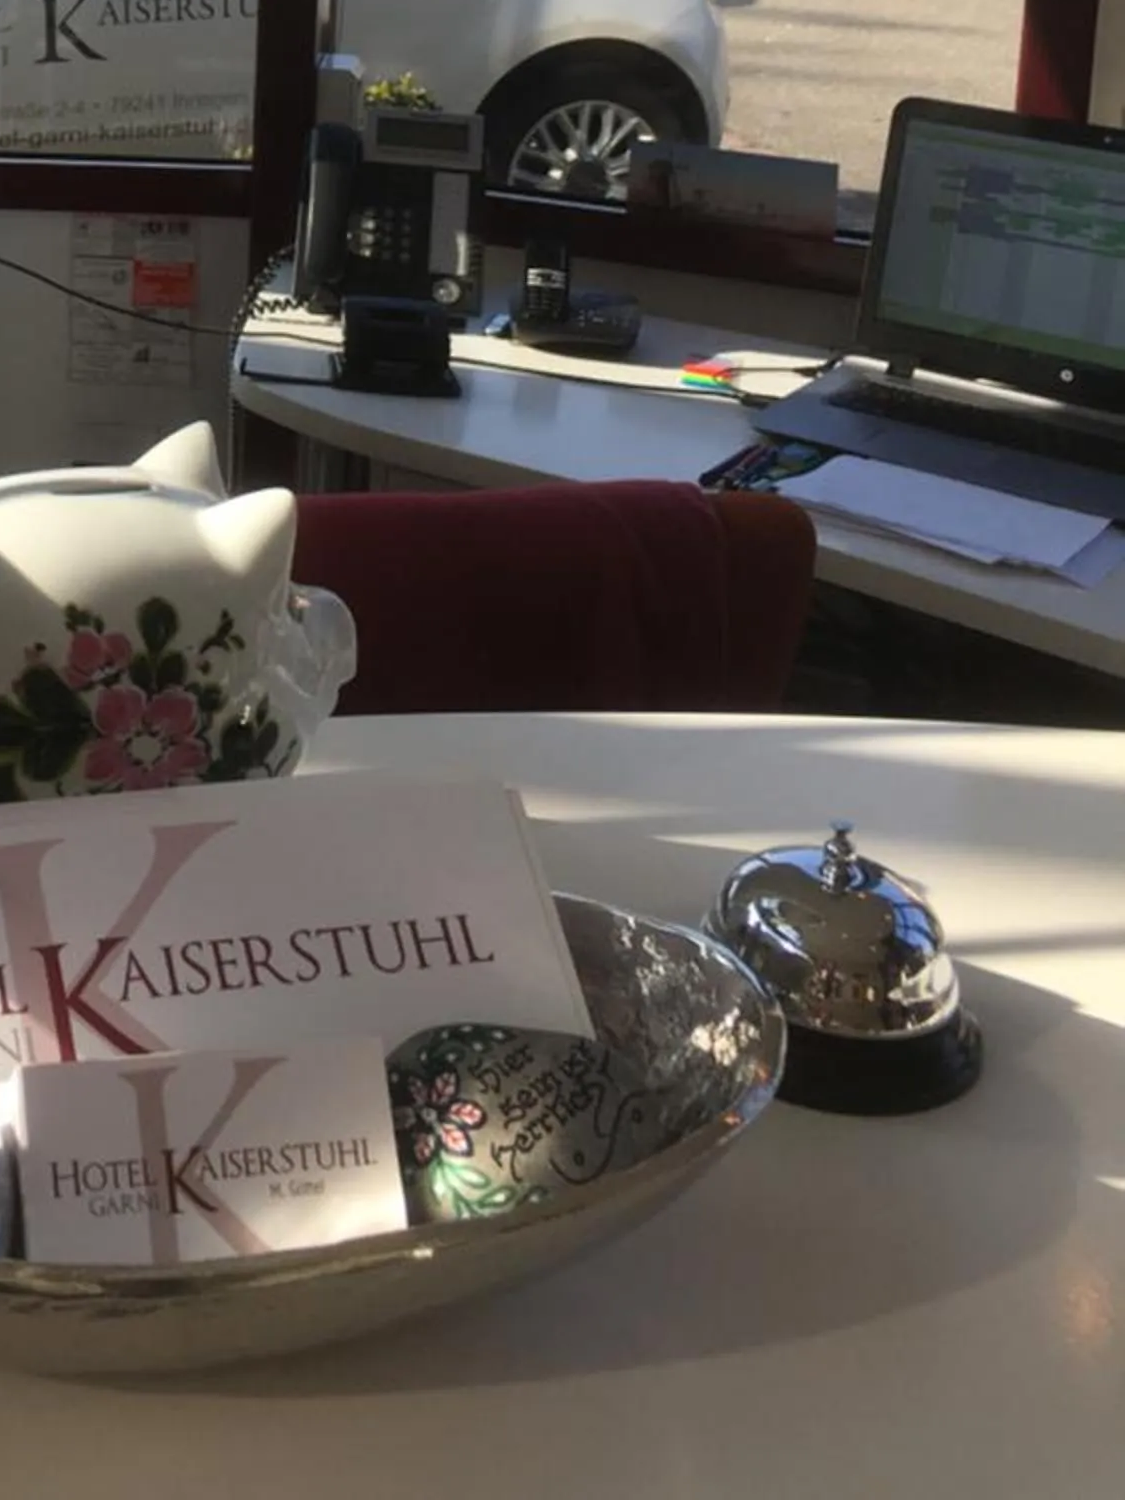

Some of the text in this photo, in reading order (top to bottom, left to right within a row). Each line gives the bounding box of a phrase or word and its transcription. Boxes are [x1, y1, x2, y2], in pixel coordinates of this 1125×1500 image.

[31, 913, 495, 1063] KAISERSTUHL
[48, 1137, 379, 1216] HOTEL KAISERSTUHL
[88, 1192, 160, 1218] GARNI
